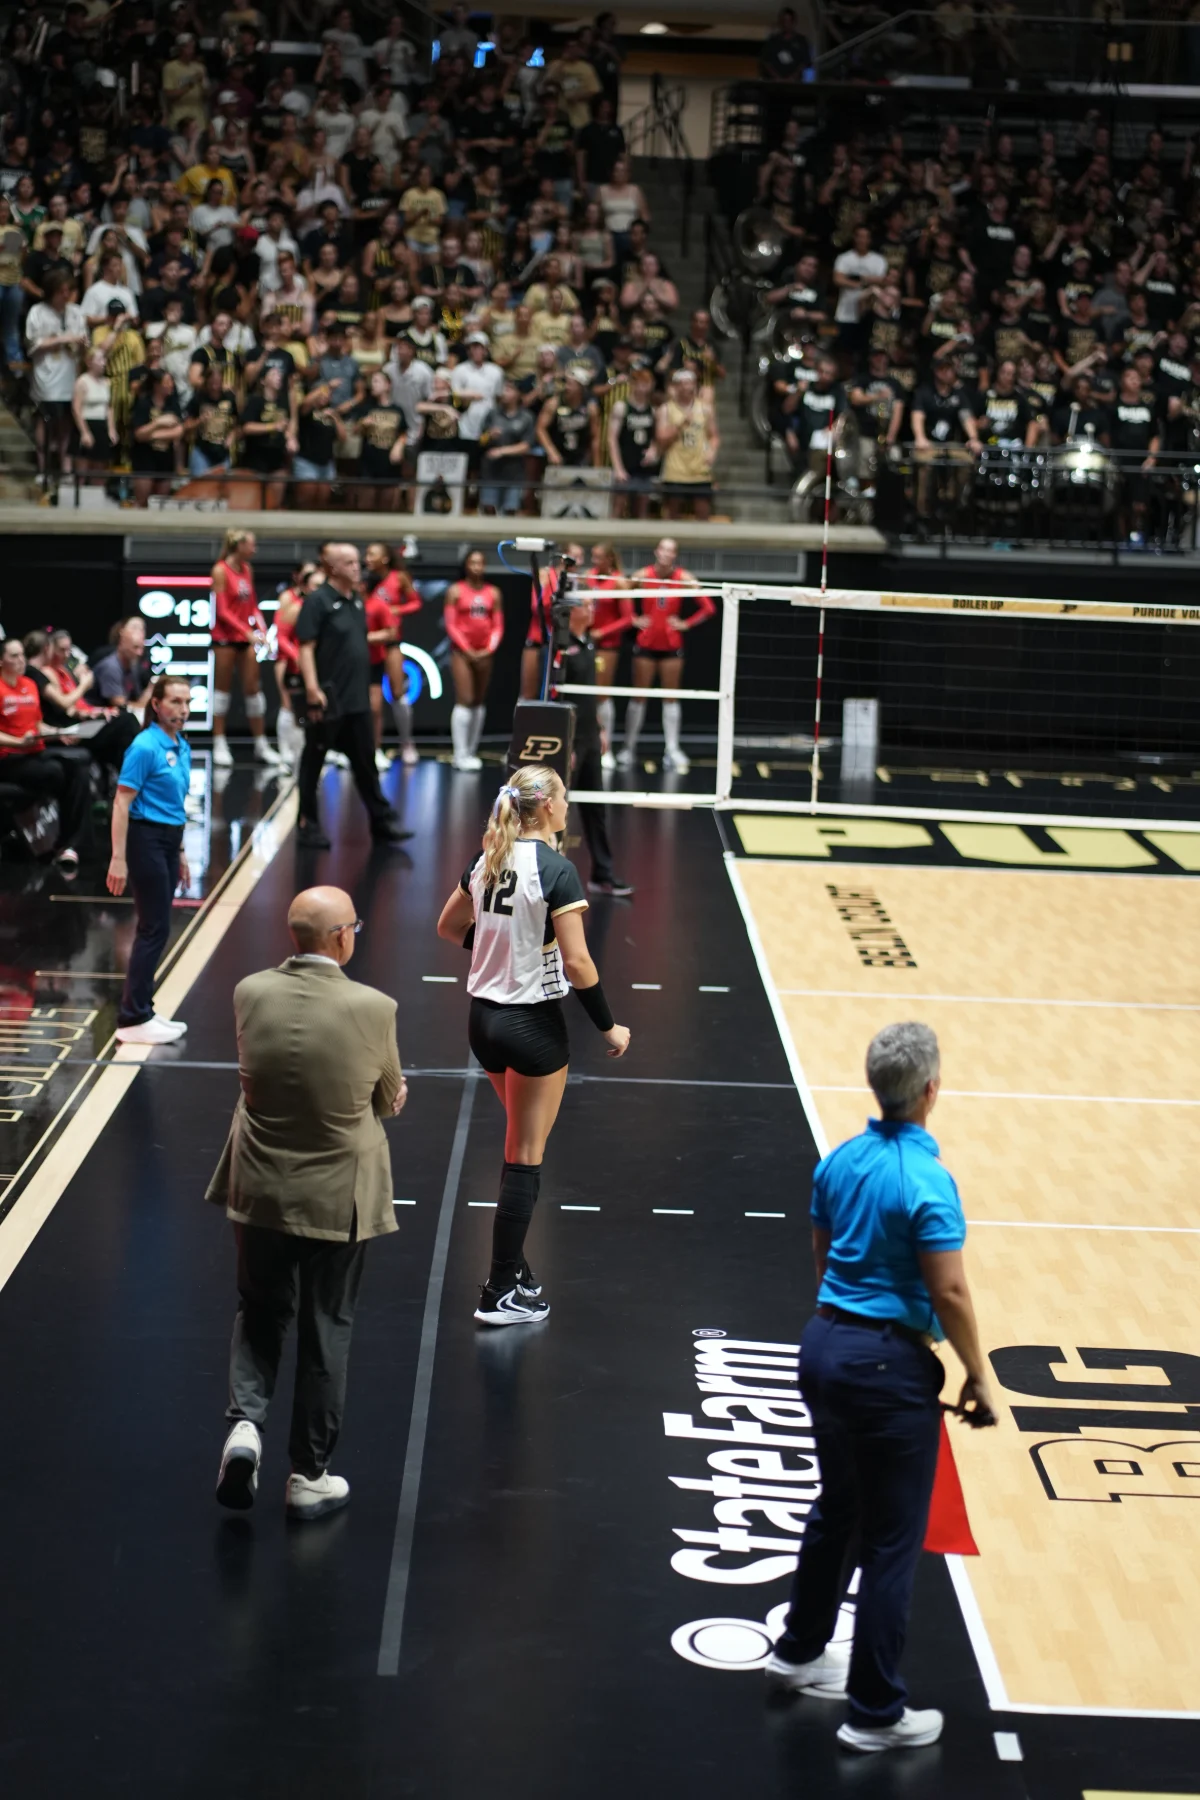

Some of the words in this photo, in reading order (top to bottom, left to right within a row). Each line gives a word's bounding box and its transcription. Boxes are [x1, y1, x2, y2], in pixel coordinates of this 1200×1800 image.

[174, 599, 211, 627] 13
[952, 599, 988, 610] BOILER
[990, 600, 1004, 610] UP
[1132, 607, 1176, 618] PURDUE
[482, 869, 519, 917] 12
